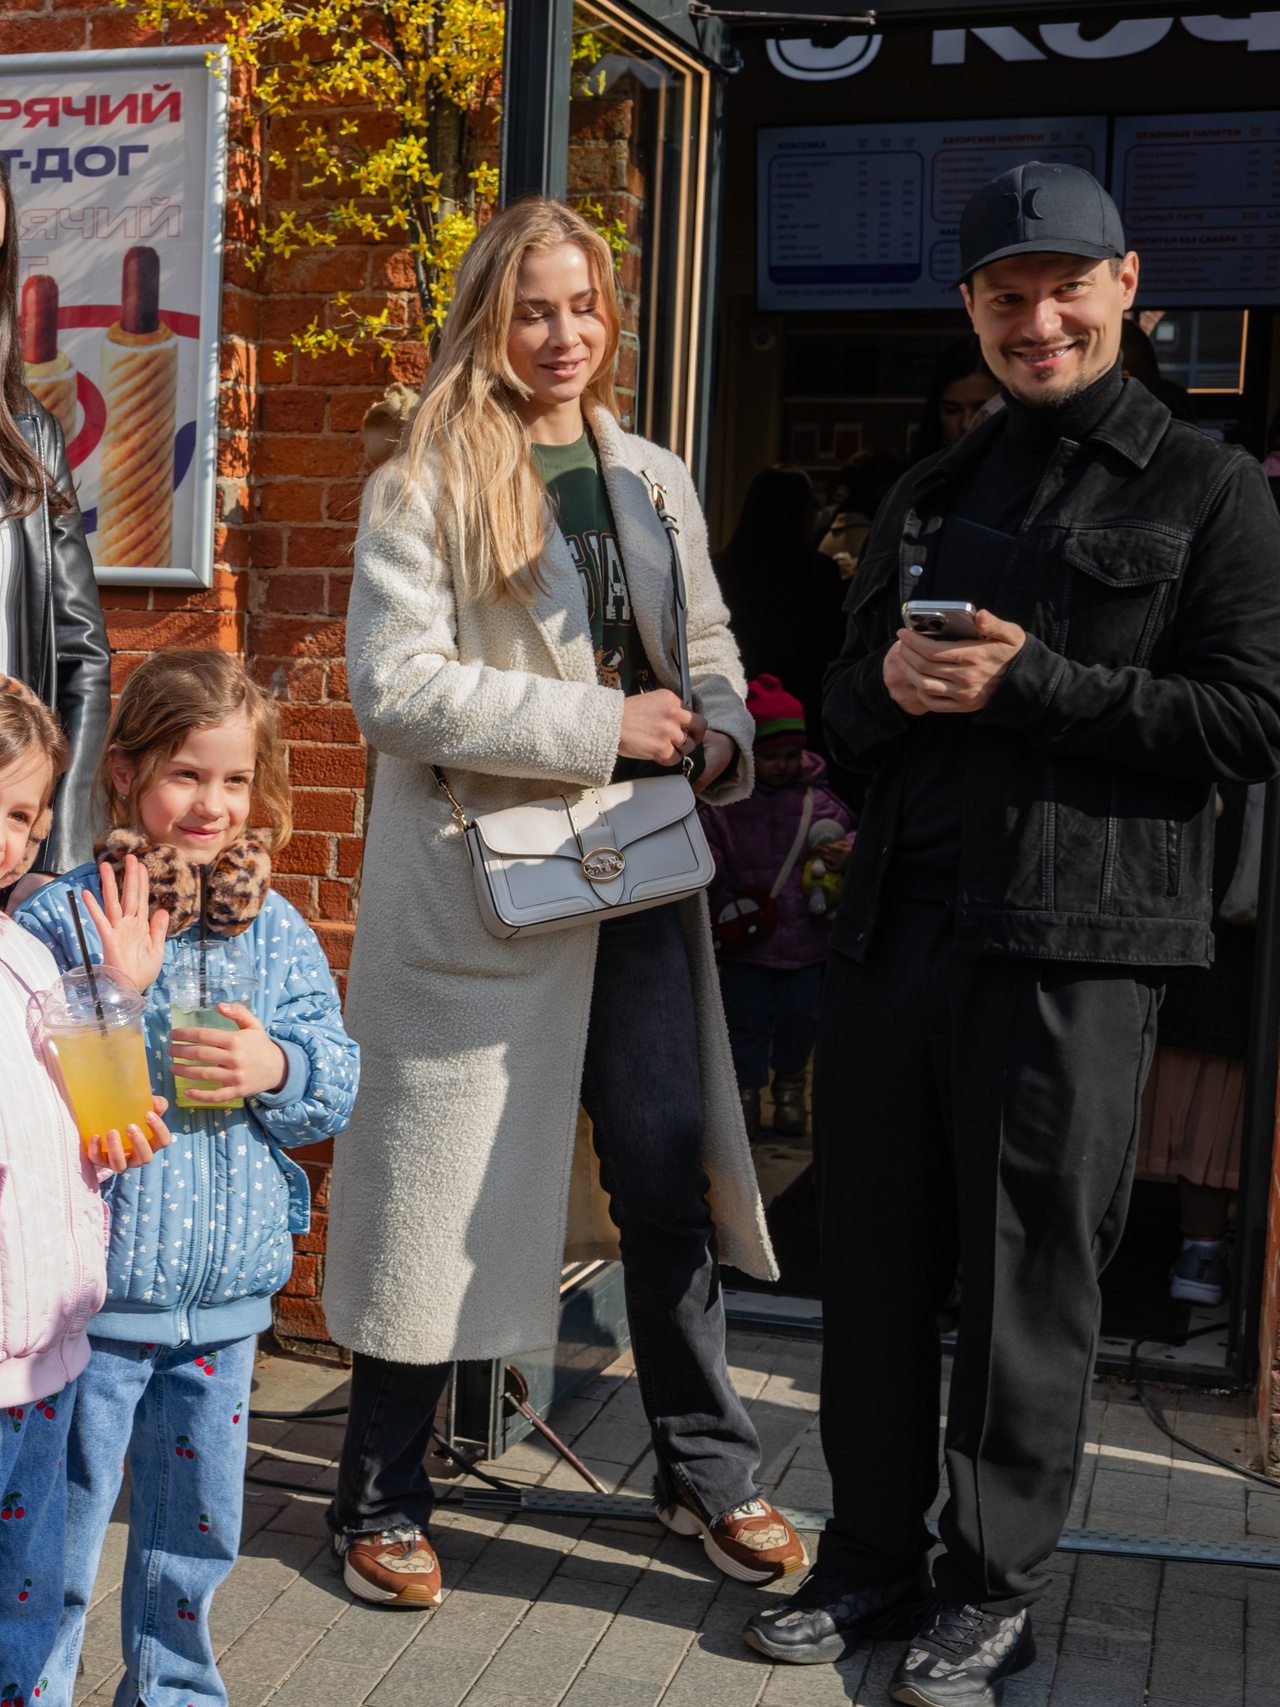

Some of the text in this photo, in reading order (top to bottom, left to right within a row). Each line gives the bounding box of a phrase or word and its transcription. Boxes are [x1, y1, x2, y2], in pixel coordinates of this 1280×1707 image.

[1193, 128, 1242, 137] НАПИТКИ
[18, 196, 181, 240] ЯЧИЙ
[1199, 234, 1238, 243] САХАРА
